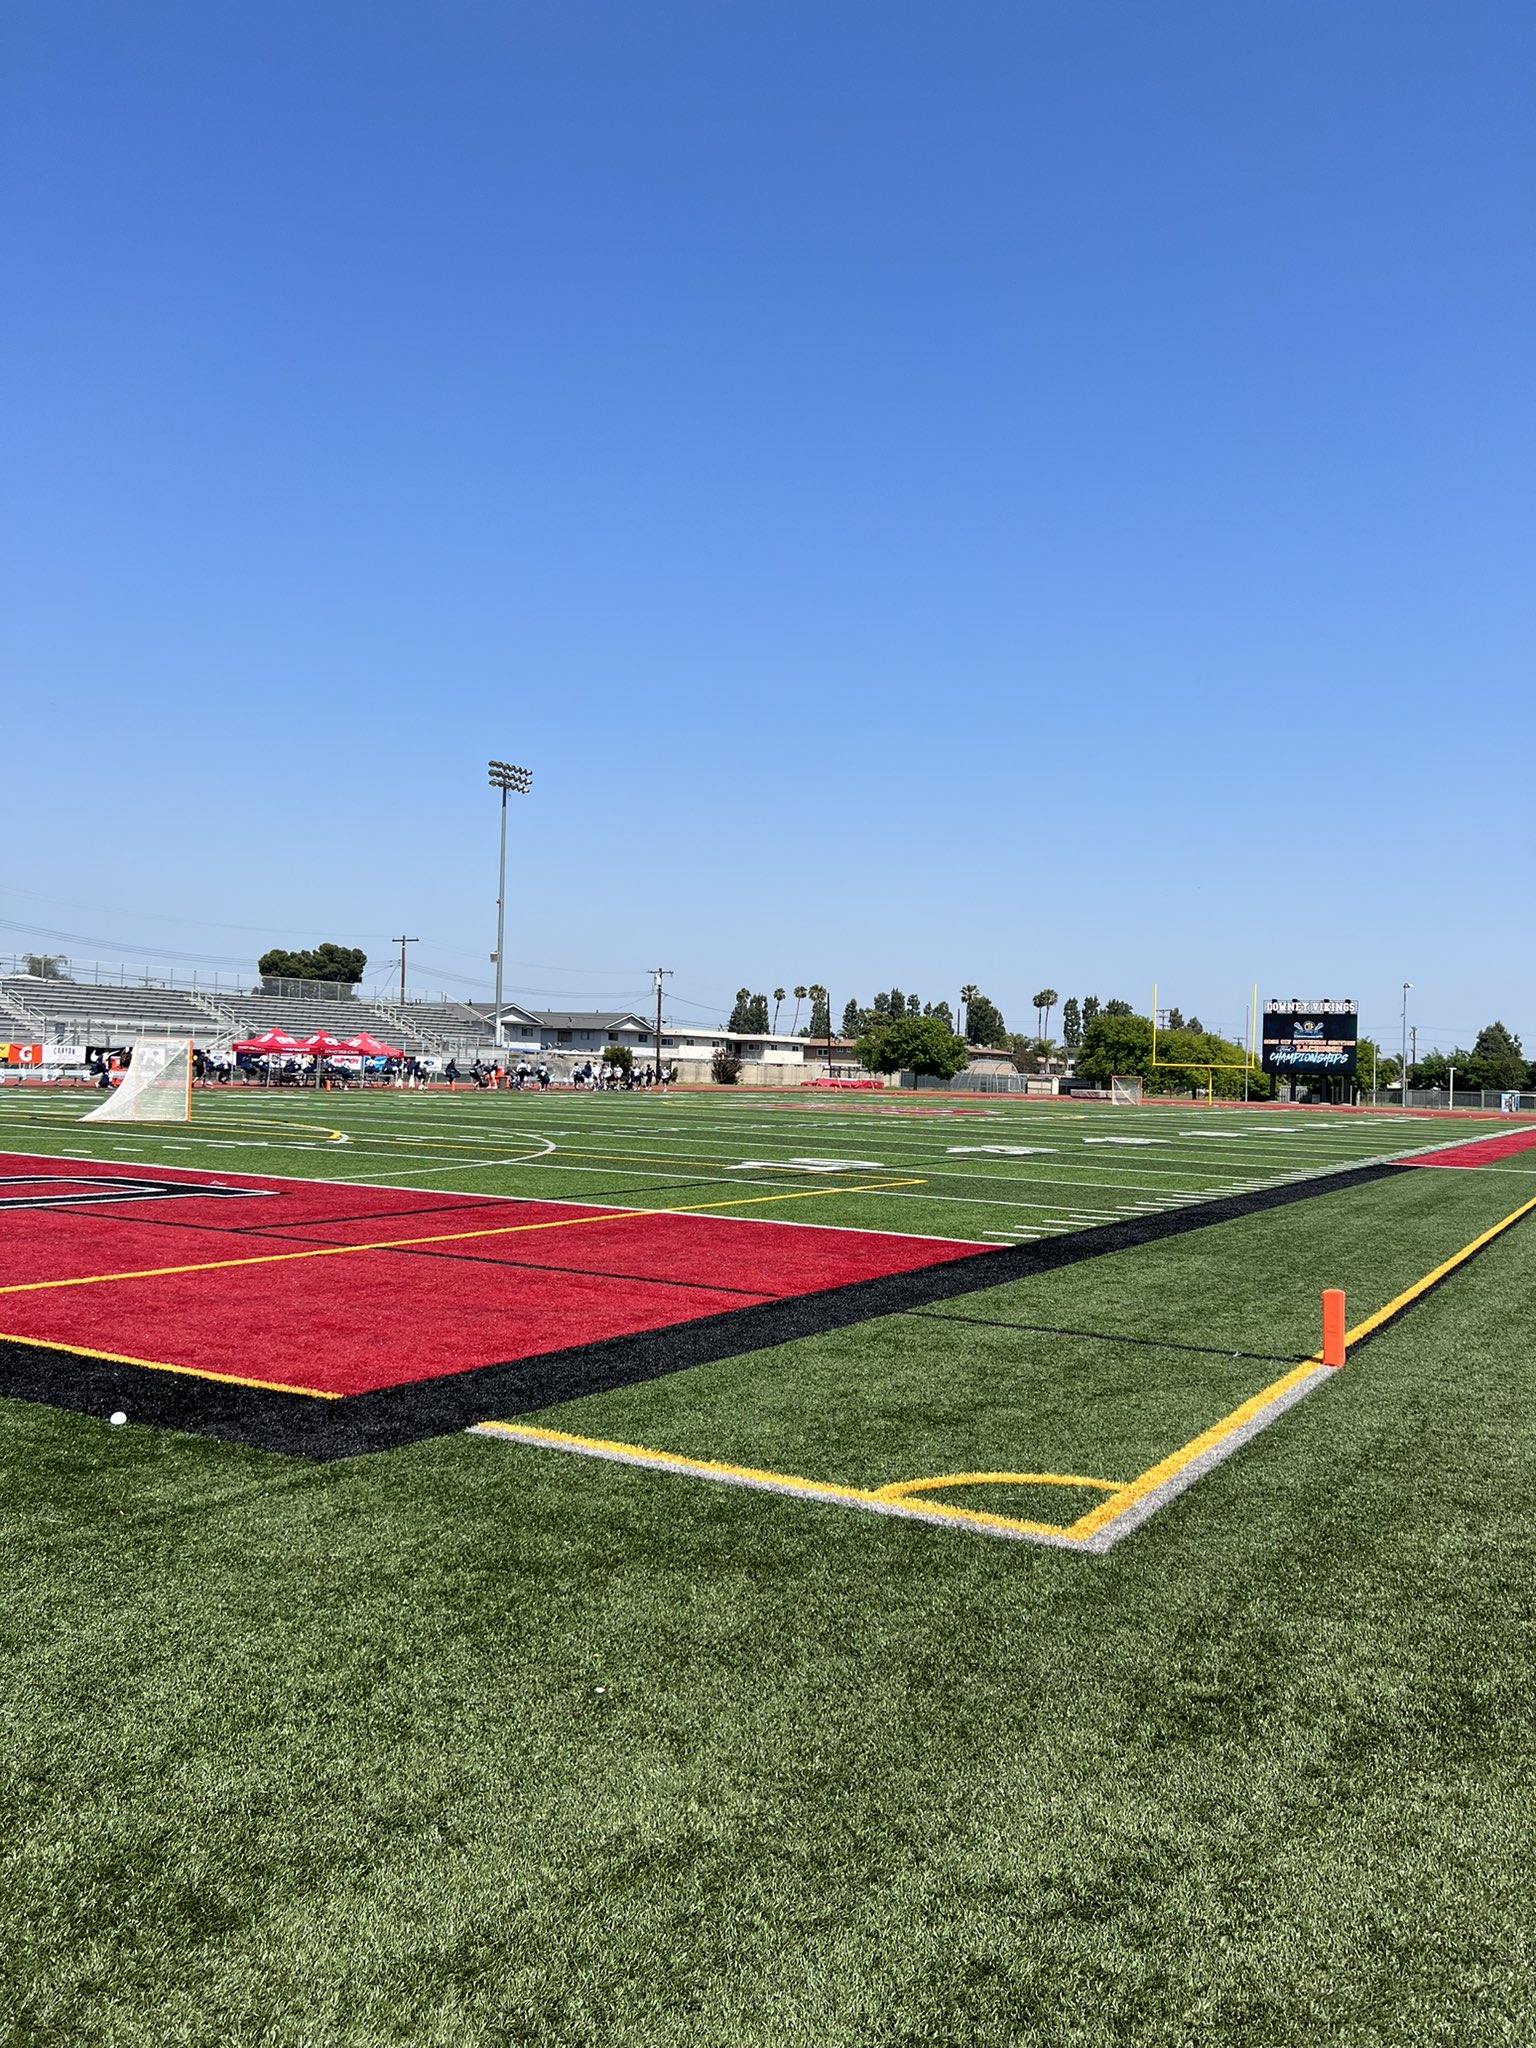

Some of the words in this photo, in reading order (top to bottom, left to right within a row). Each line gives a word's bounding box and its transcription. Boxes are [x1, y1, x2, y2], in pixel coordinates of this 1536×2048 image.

[1266, 1002, 1310, 1011] DOWNEY
[1312, 1002, 1355, 1011] VIKINGS
[1269, 1052, 1349, 1067] CHAMPIONSHIPS
